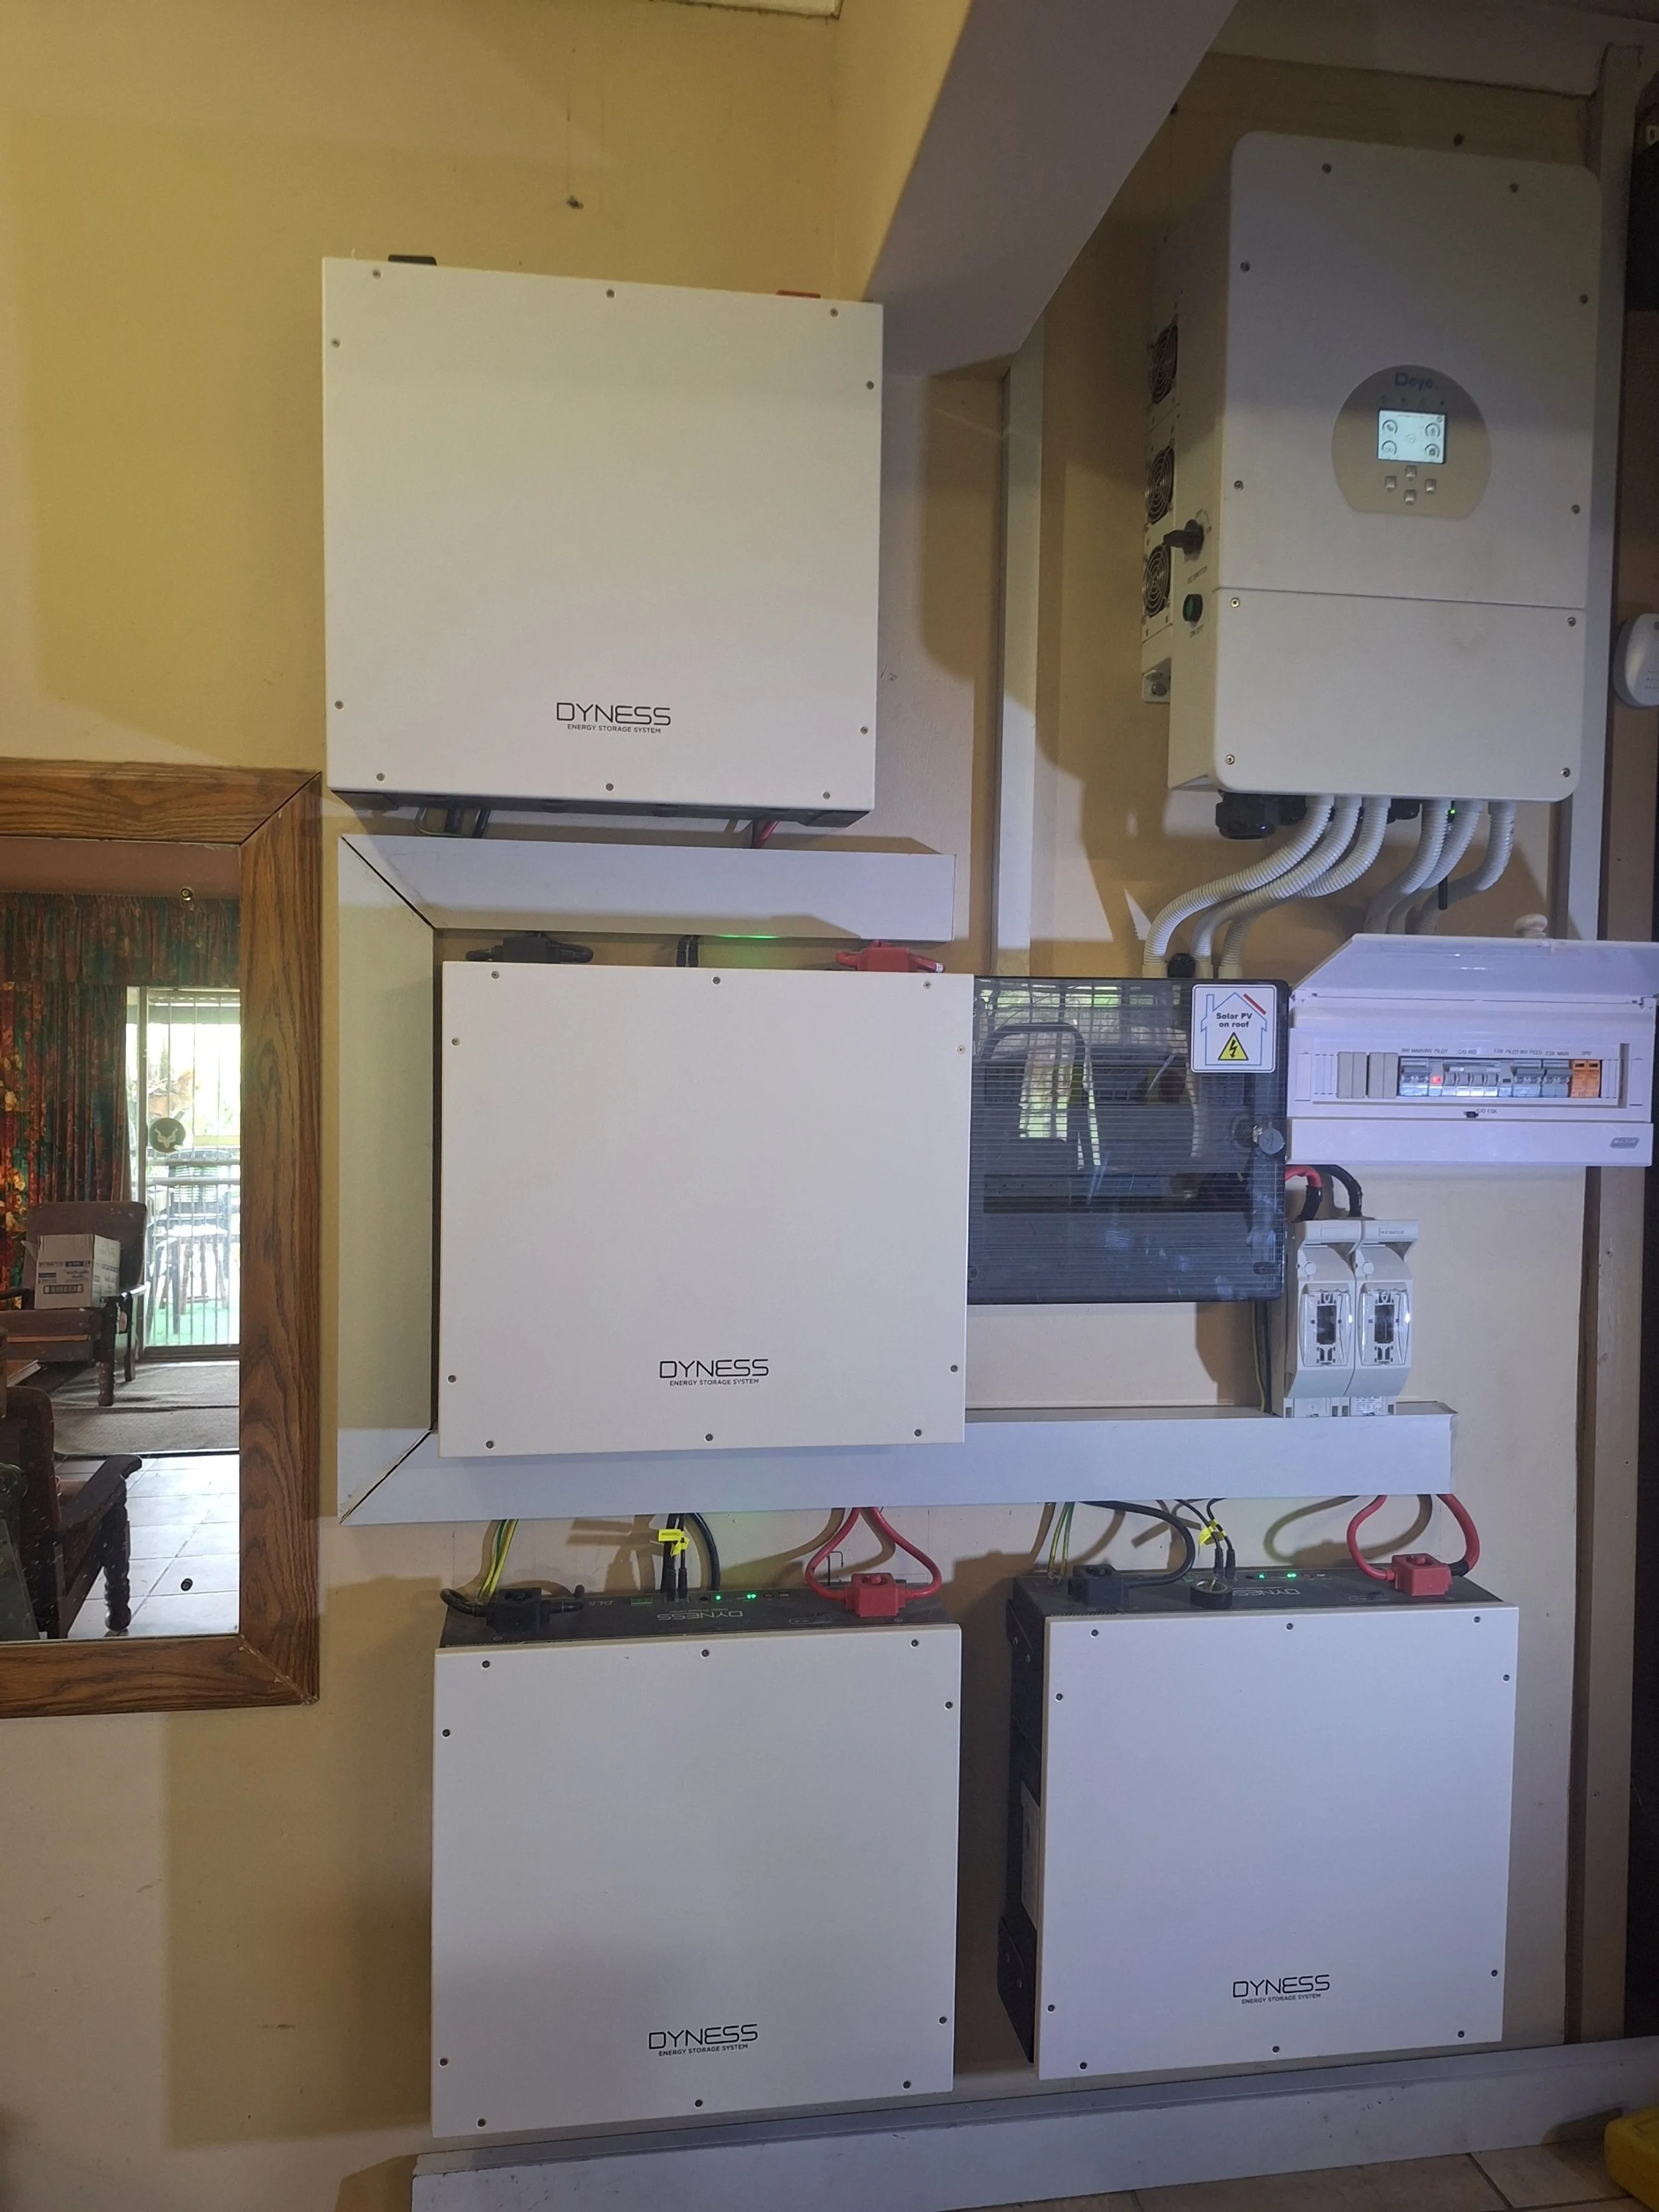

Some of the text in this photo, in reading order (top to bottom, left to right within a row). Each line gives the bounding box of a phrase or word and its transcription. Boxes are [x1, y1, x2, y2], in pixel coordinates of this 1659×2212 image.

[556, 702, 671, 726] DYNESS
[659, 1359, 769, 1378] DYNESS
[1232, 1588, 1301, 1597] DYNES
[657, 1610, 743, 1621] DYNESS
[1233, 1974, 1330, 1998] DYNESS
[648, 2024, 758, 2049] DYNESS
